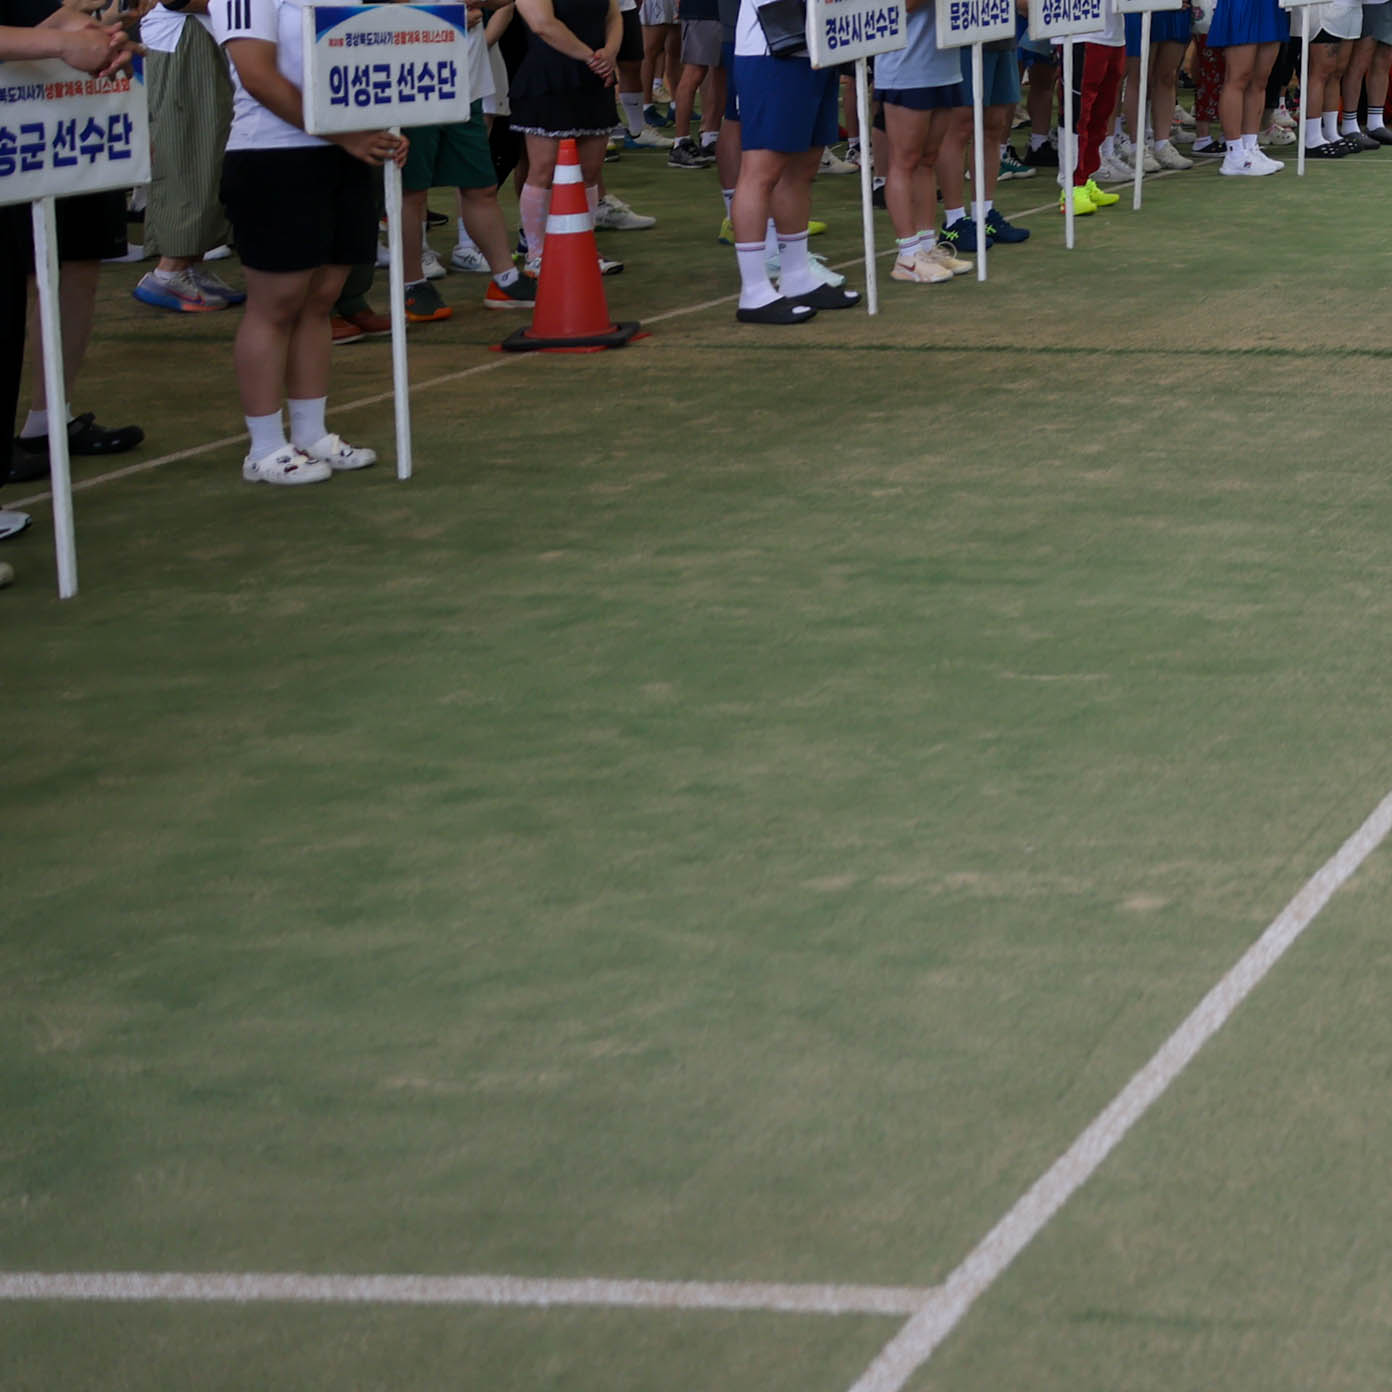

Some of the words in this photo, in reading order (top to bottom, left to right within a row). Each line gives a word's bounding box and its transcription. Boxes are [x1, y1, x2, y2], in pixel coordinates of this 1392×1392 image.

[825, 12, 862, 50] 경산시
[864, 5, 900, 41] 선수단
[950, 1, 979, 31] 문경시
[329, 63, 392, 108] 의성군
[397, 60, 457, 104] 선수단
[52, 112, 133, 169] 선수단
